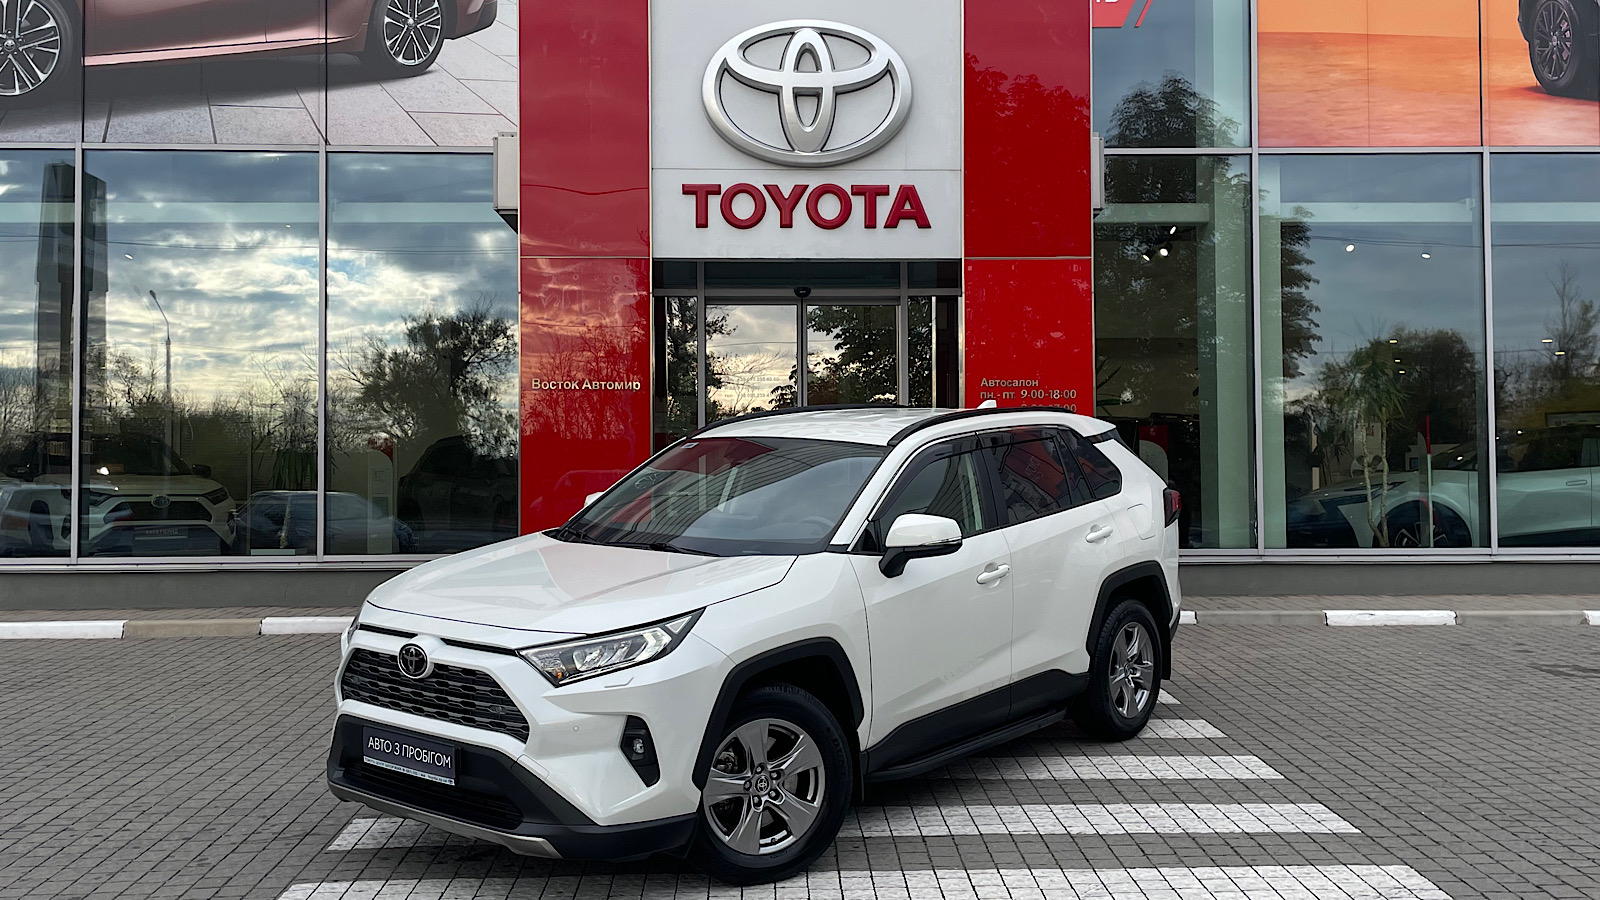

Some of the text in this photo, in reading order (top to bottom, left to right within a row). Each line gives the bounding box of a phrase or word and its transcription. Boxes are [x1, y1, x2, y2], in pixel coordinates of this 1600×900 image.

[681, 182, 932, 230] TOYOTA
[531, 378, 641, 392] Восток Автомир
[980, 377, 1039, 387] Автосалон
[368, 737, 392, 753] АВТО
[402, 744, 451, 769] ПРОБІГОМ
